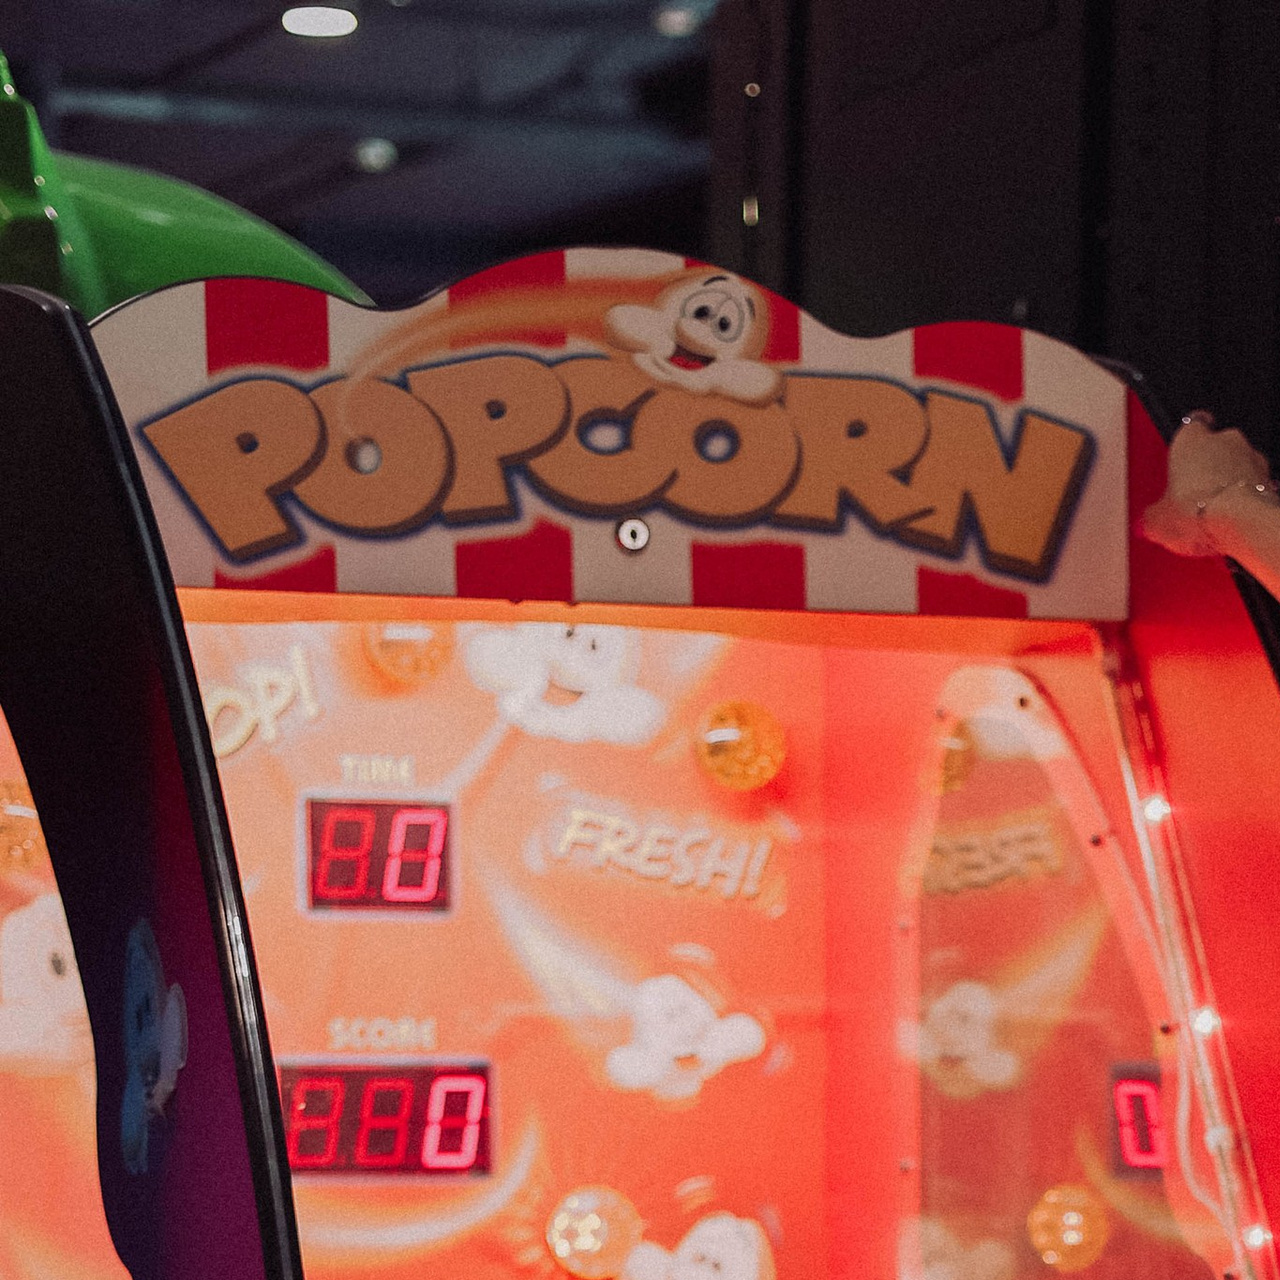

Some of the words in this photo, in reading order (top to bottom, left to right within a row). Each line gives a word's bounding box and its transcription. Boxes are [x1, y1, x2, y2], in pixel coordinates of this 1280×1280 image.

[137, 351, 1096, 586] POPCORN
[553, 808, 772, 898] FRESH!
[328, 1017, 437, 1050] SCORE
